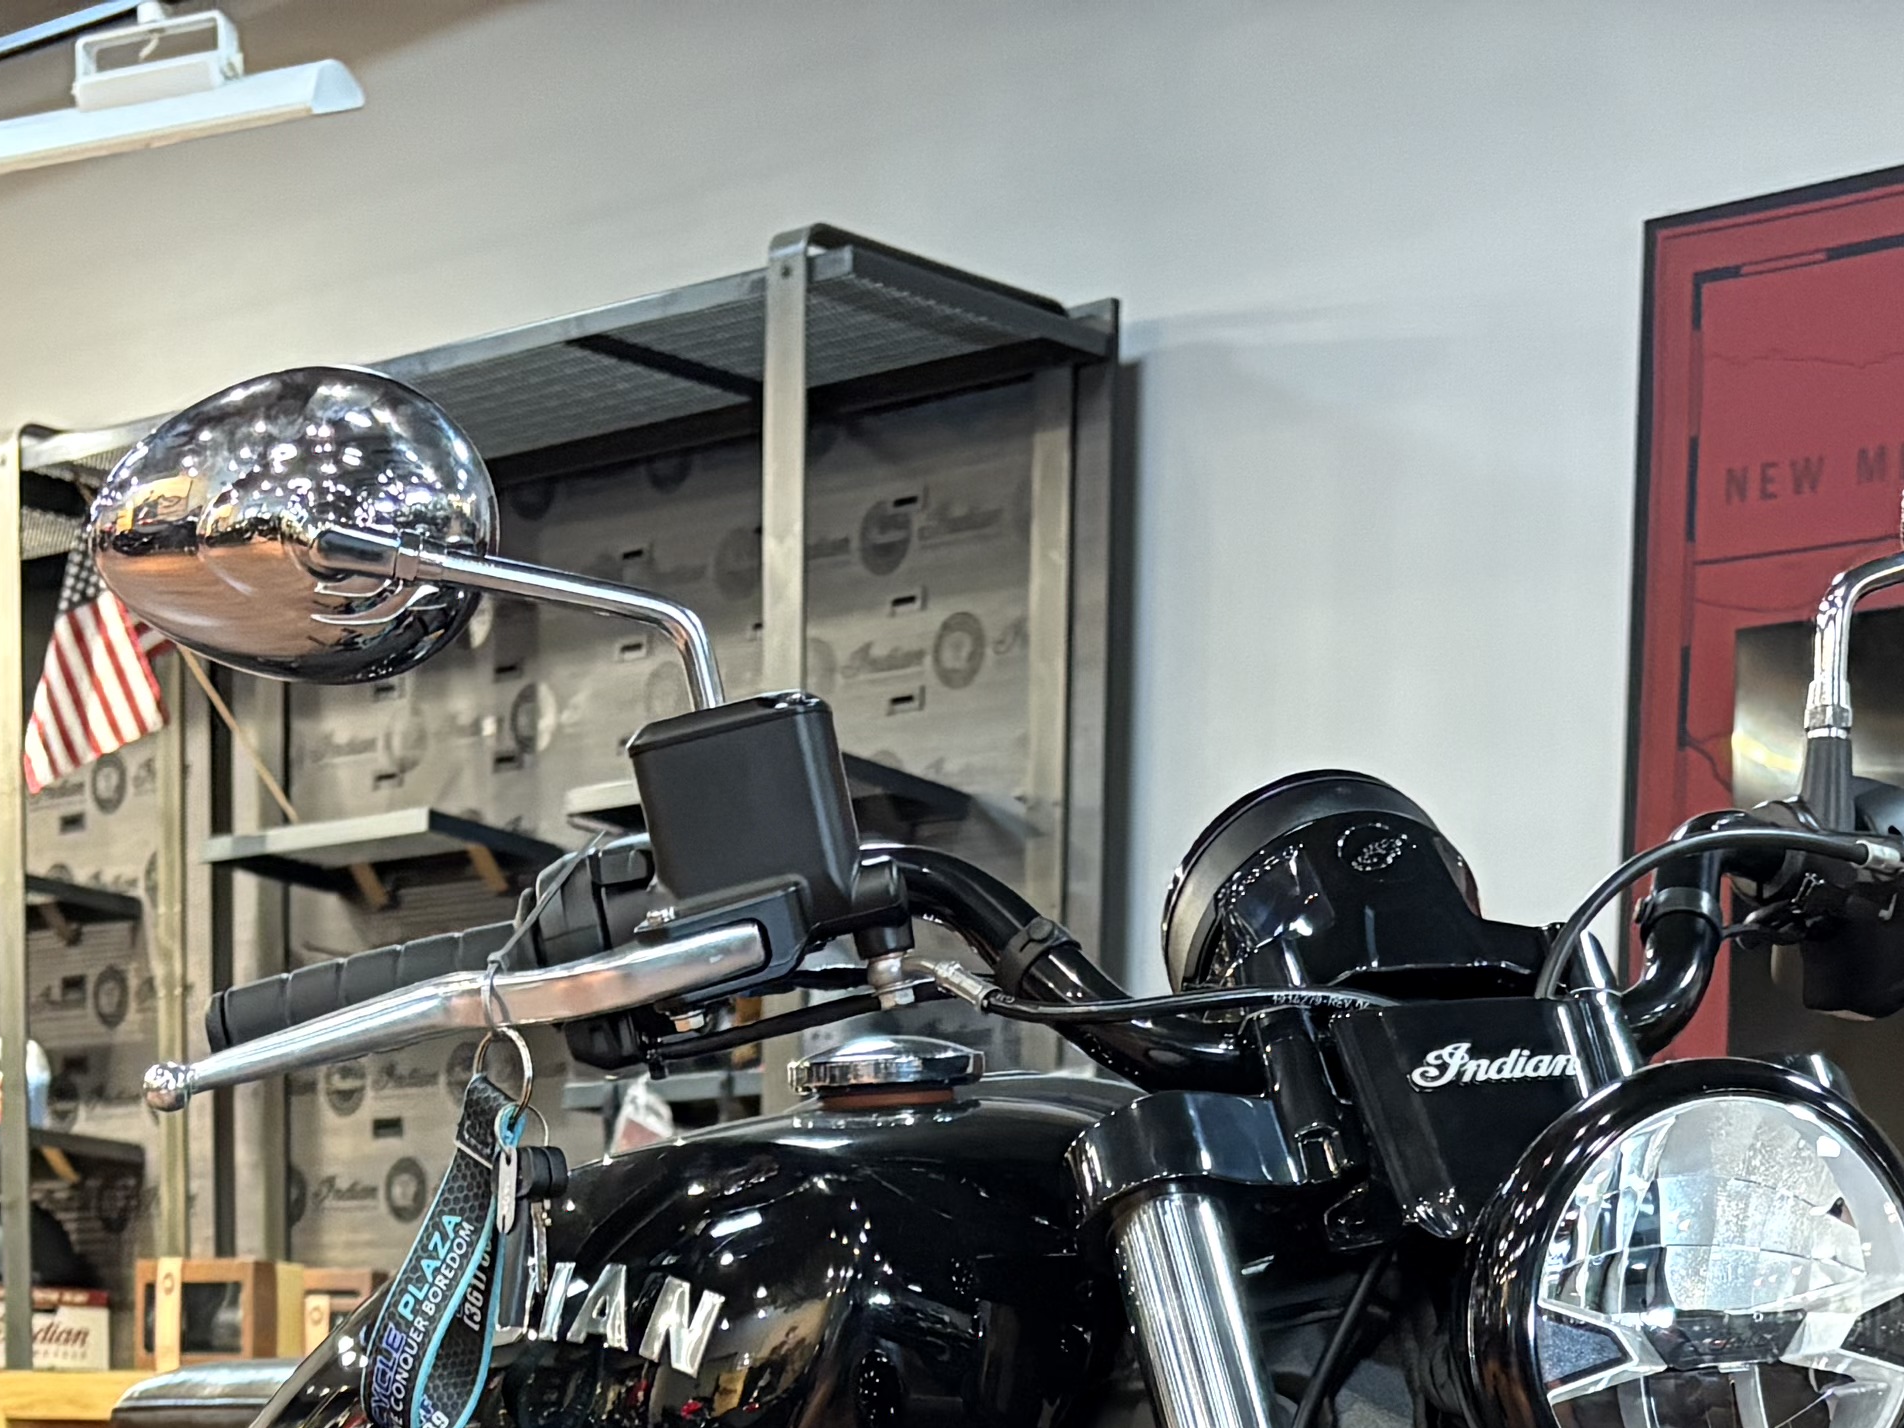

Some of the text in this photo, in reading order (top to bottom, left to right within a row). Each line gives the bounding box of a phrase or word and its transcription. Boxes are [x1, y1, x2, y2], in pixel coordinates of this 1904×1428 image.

[1725, 455, 1825, 506] NEW
[1410, 1042, 1580, 1090] Indian
[391, 1317, 430, 1411] CONQUER
[422, 1220, 475, 1315] BOREDOM
[398, 1214, 462, 1322] PLAZA
[539, 1261, 726, 1377] IAN
